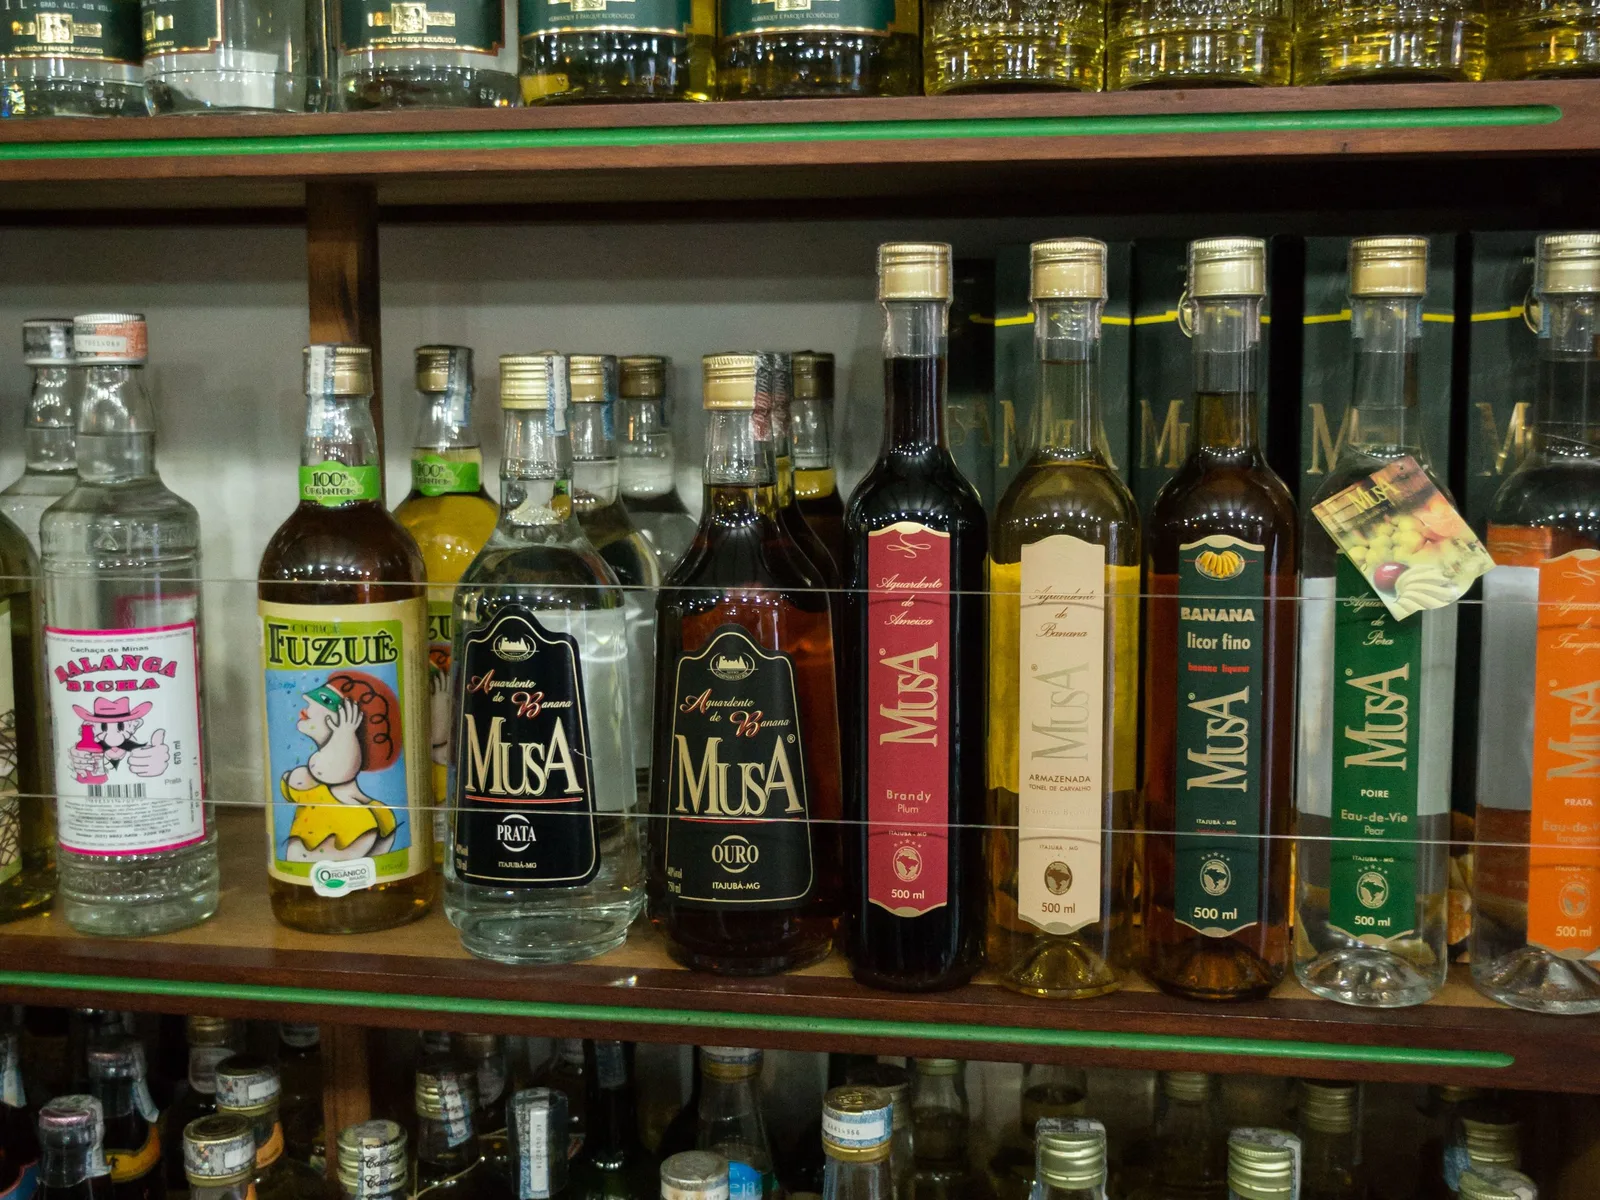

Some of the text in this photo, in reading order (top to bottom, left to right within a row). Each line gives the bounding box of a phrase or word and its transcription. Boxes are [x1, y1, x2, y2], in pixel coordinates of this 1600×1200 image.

[1347, 477, 1400, 514] MUSA
[876, 573, 942, 592] Aguardente
[901, 594, 914, 608] de
[884, 611, 935, 626] Ameixa
[1054, 607, 1068, 619] de
[1180, 607, 1256, 622] BANANA
[1370, 613, 1385, 627] de
[1036, 621, 1088, 638] Banana
[1576, 616, 1592, 631] de
[1187, 632, 1251, 651] licor fino
[1362, 628, 1395, 646] Pera
[70, 646, 105, 654] Cachaça
[268, 623, 398, 667] FUZUÊ
[466, 669, 536, 694] Aguardente
[679, 688, 755, 714] Aguardente
[879, 641, 939, 748] MUSA
[492, 691, 573, 719] de Banana
[1031, 661, 1090, 762] MUSA
[709, 710, 790, 737] de Banana
[1344, 662, 1410, 772] MUSA
[1187, 686, 1250, 793] MUSA
[464, 713, 585, 797] MUSA
[675, 734, 805, 817] MUSA
[1029, 774, 1091, 783] ARMAZENADA
[886, 789, 932, 803] Brandy
[1360, 789, 1389, 798] POIRE
[897, 804, 919, 814] Plum
[1340, 809, 1409, 823] Eau-de-Vie
[496, 823, 537, 843] PRATA
[1363, 825, 1386, 836] Pear
[711, 844, 760, 865] OURO
[320, 867, 367, 882] ORGÂNICO
[891, 889, 925, 900] 500 ml
[1041, 902, 1076, 914] 500 ml
[1193, 907, 1238, 920] 500 ml
[1354, 915, 1391, 927] 500 ml
[1555, 926, 1592, 937] 500 ml
